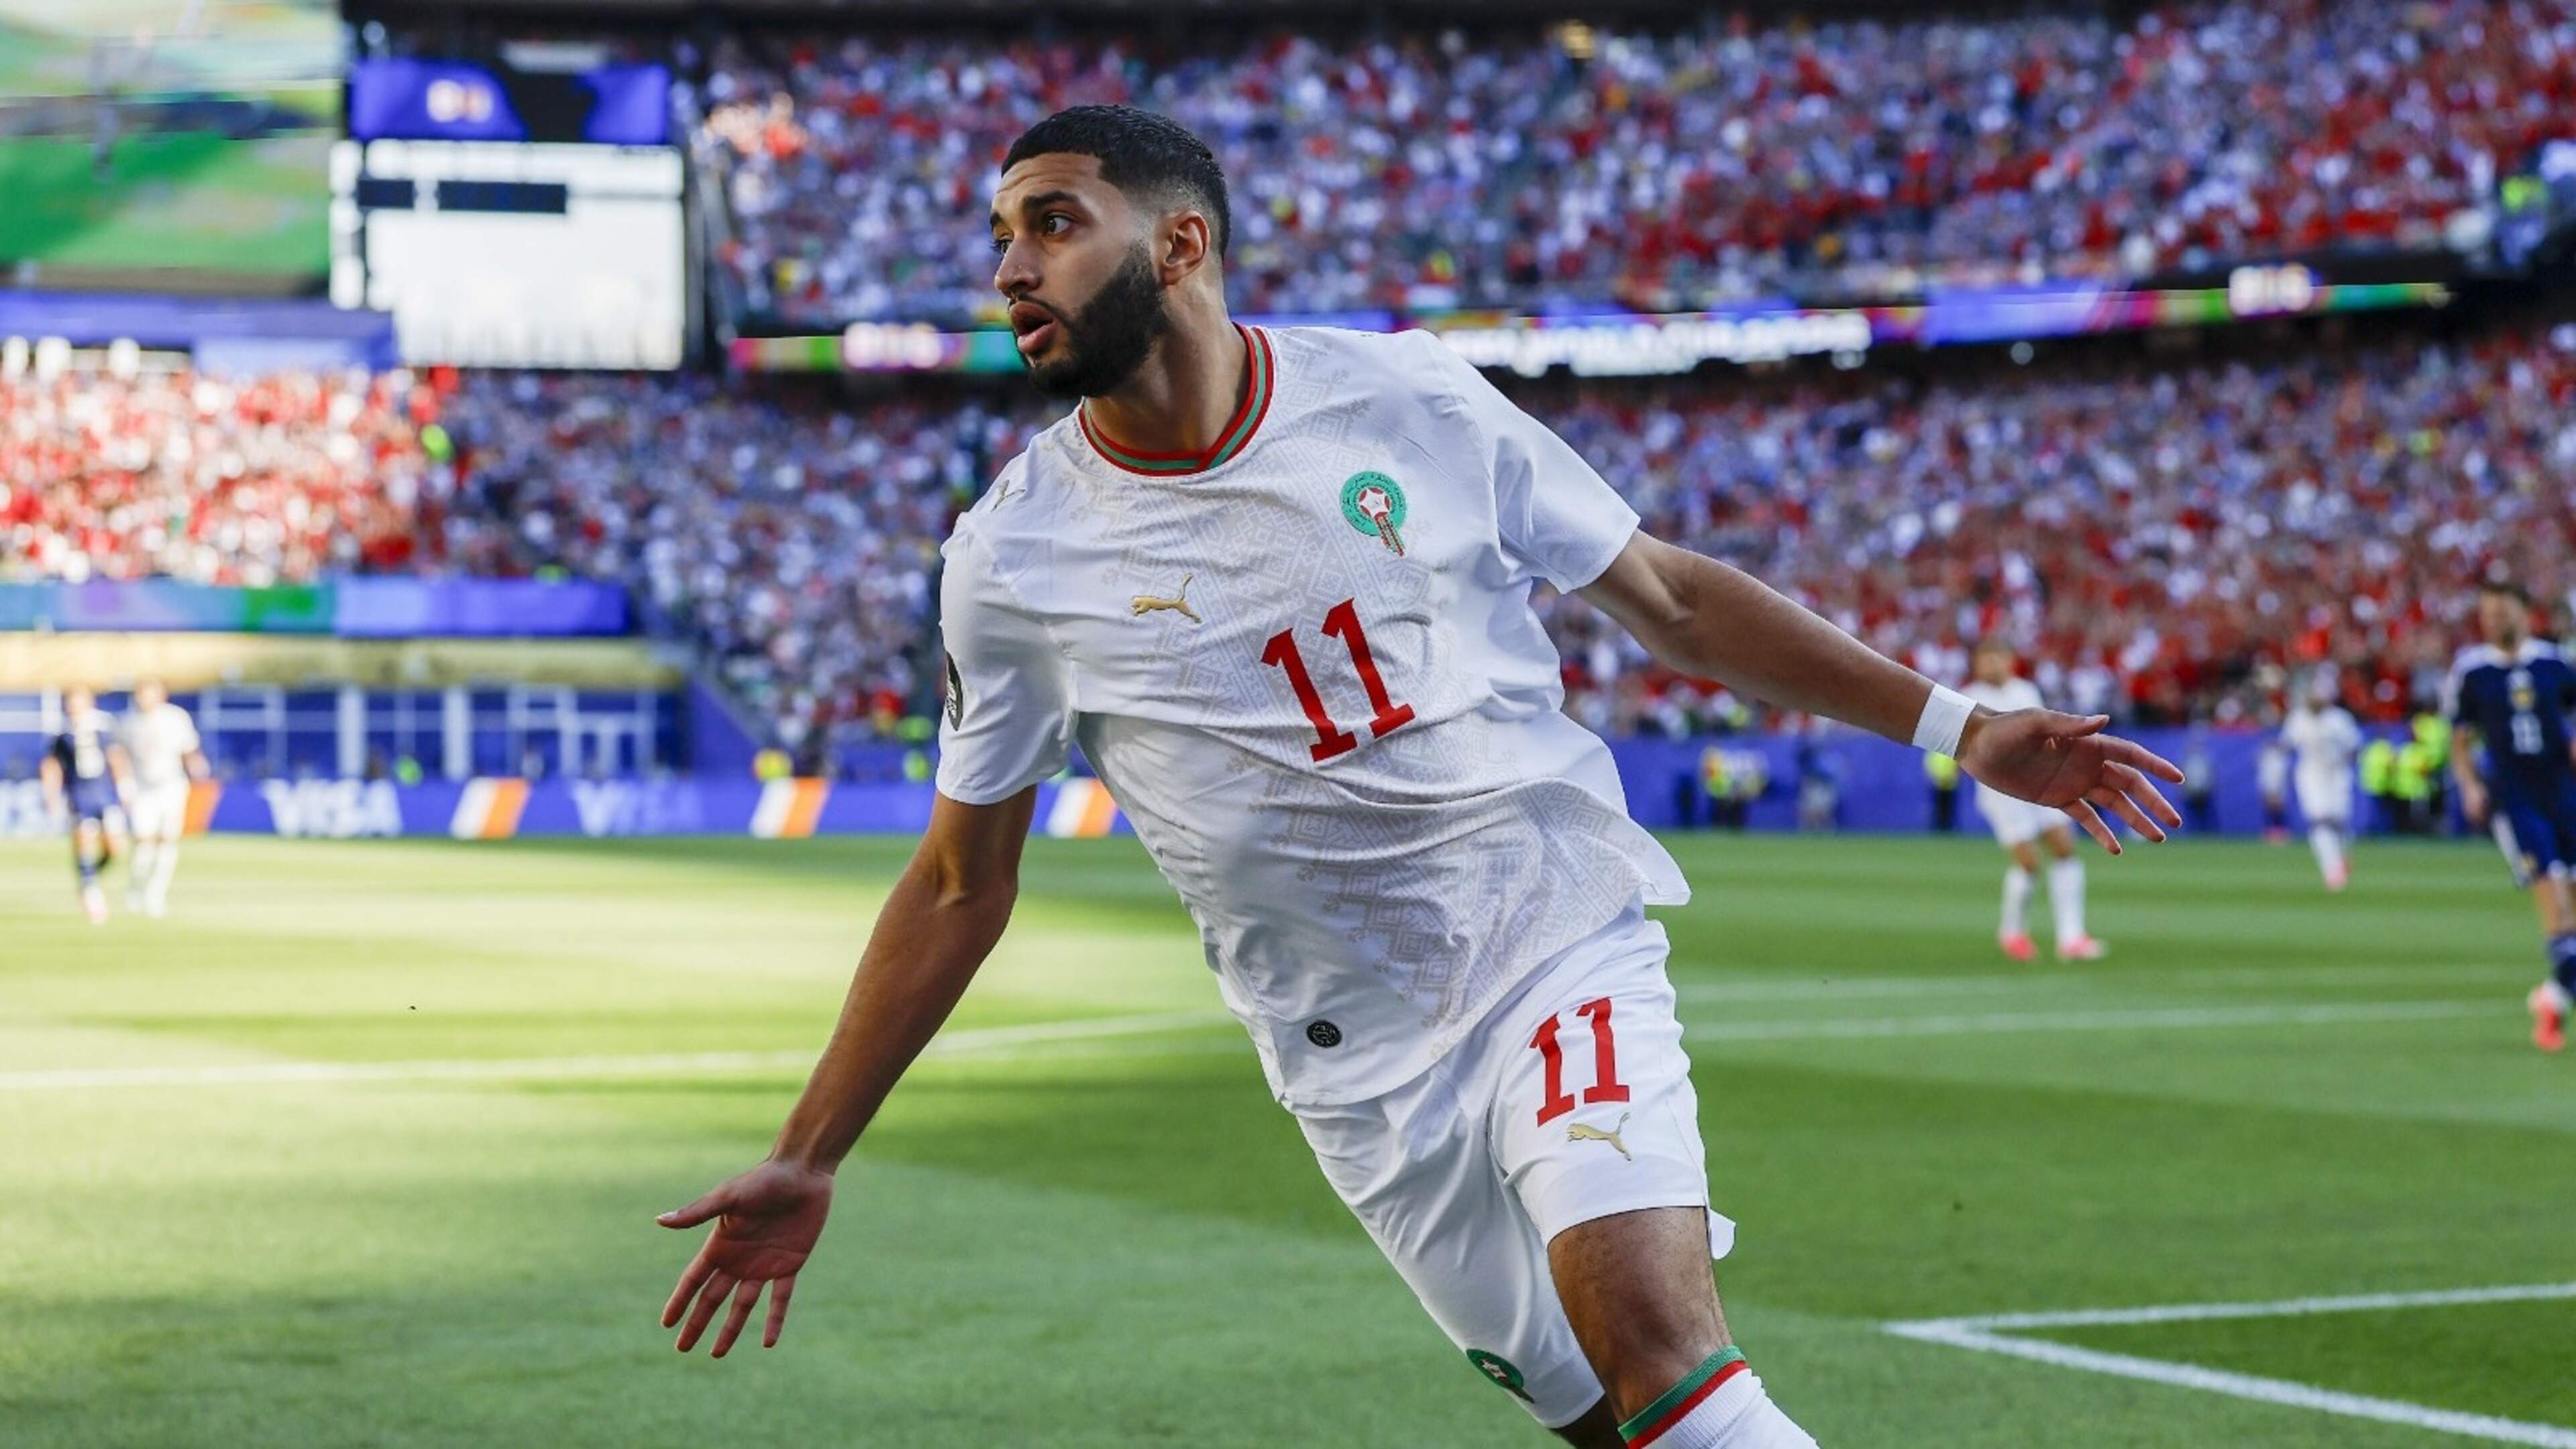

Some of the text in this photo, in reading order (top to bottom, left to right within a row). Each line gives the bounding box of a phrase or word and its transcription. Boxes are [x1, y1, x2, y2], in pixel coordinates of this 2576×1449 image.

[1260, 597, 1415, 762] 11
[264, 779, 405, 835] VISA
[1529, 997, 1629, 1128] 11
